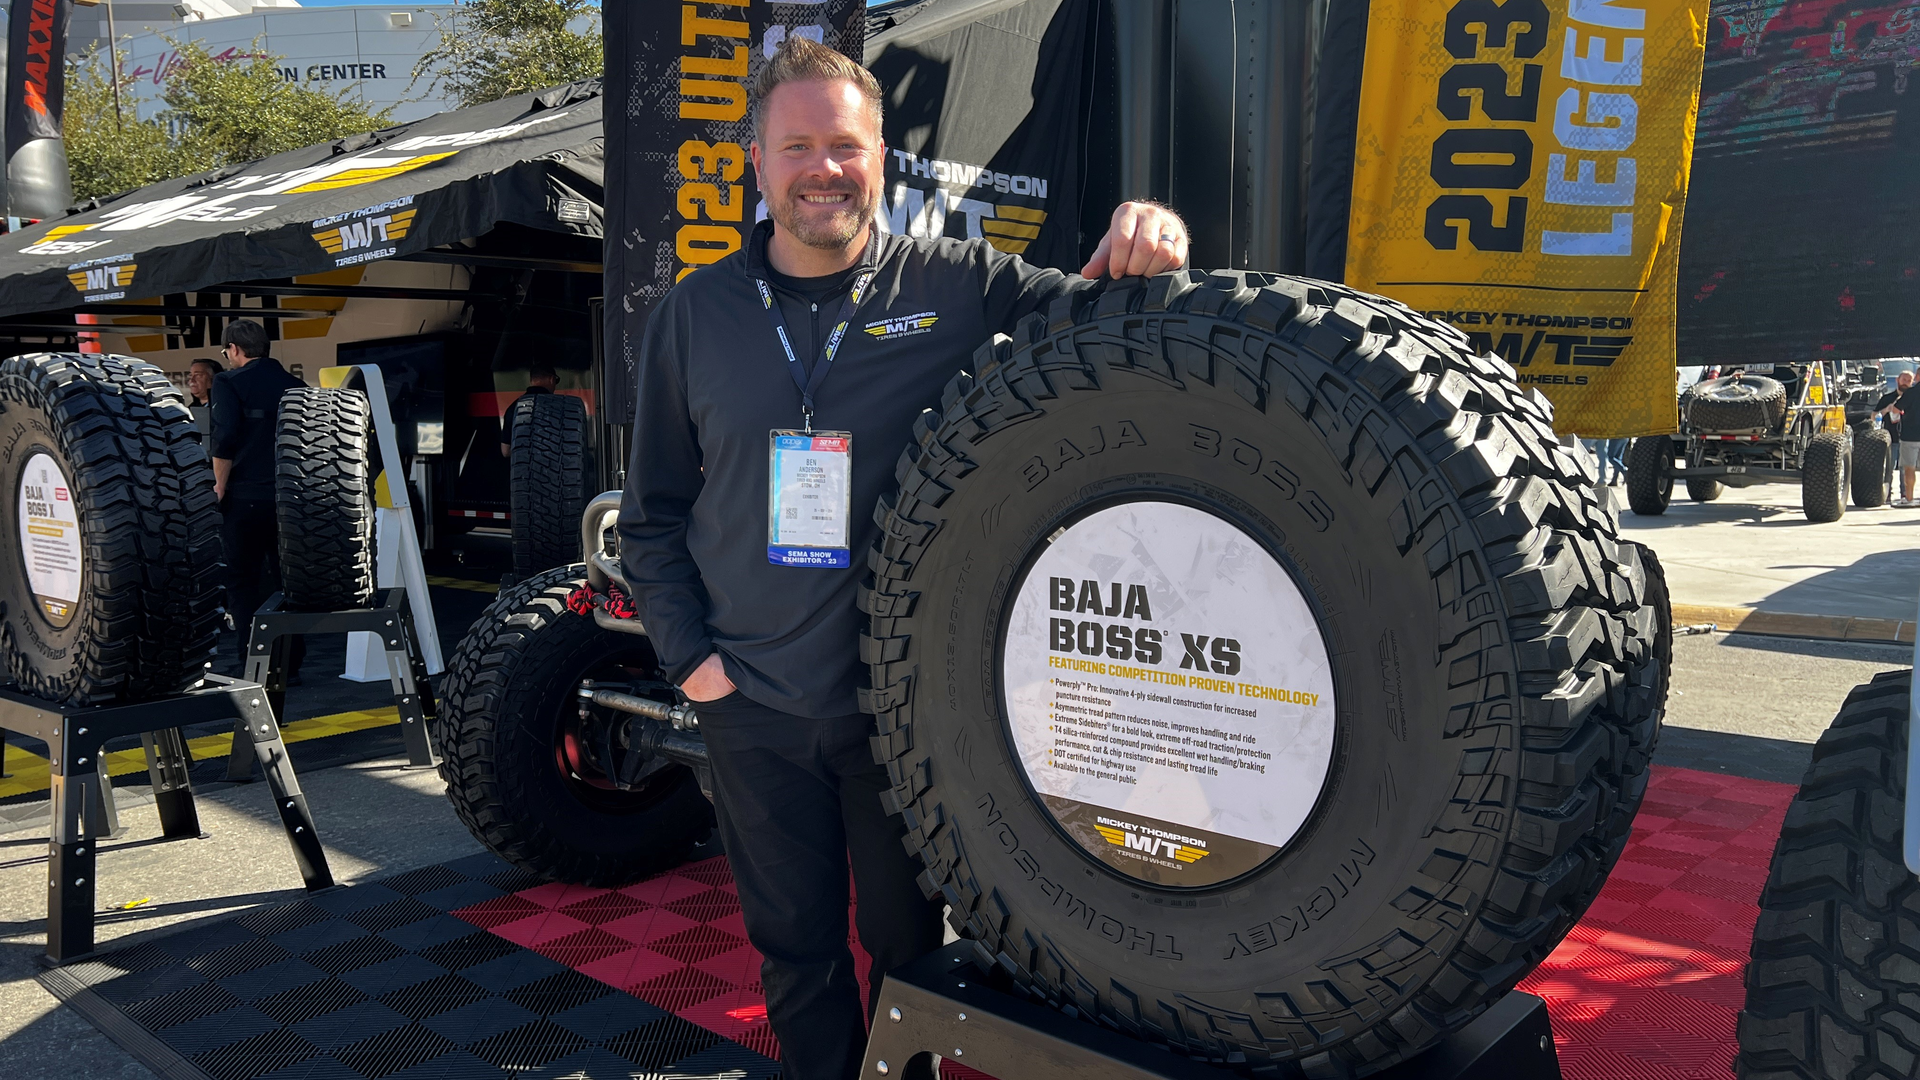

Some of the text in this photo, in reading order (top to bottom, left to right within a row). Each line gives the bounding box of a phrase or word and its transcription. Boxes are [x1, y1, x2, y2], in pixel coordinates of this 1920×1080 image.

[24, 0, 58, 116] MAXXI
[307, 63, 387, 81] CENTER
[1424, 0, 1550, 253] 2023
[893, 149, 1048, 199] THOMPSON
[312, 194, 415, 229] MICKEY THOMPSON
[339, 215, 393, 251] M/T
[335, 254, 358, 267] TIRES
[364, 247, 397, 261] WHEELS
[86, 265, 121, 291] M/T
[865, 311, 937, 329] MICKEY THOMPSON
[875, 333, 898, 341] TIRES
[903, 328, 932, 337] WHEELS
[885, 319, 923, 334] M/T
[1419, 310, 1634, 330] ICKEY THOMPSON
[1516, 374, 1589, 386] WHEELS
[806, 458, 817, 466] BEN
[1015, 420, 1148, 494] BAJA
[1184, 422, 1336, 534] BOSS
[25, 485, 44, 501] BAJA
[27, 501, 55, 518] BOSS X
[782, 556, 822, 564] EXHIBITOR
[1285, 543, 1335, 615] OUTSIDE
[1049, 576, 1152, 622] BAJA
[1179, 632, 1242, 676] XS
[1049, 656, 1319, 707] FEATURING COMPETITION PROVEN TECHNOLOGY
[1055, 691, 1112, 707] puncture resistance
[1087, 685, 1099, 693] Pro:
[1100, 685, 1130, 698] Innovative
[1130, 690, 1146, 701] 4-ply
[1147, 692, 1171, 704] sidewall
[1172, 698, 1213, 711] construction
[1213, 703, 1223, 712] for
[1224, 704, 1257, 718] increased
[1054, 702, 1256, 745] Asymmetric tread pattern reduces noise, improves handling and ride
[1054, 713, 1078, 725] Extreme
[1112, 724, 1121, 732] for
[1126, 726, 1139, 736] bold
[1140, 729, 1155, 739] look,
[1156, 732, 1181, 744] extreme
[1182, 736, 1207, 749] off-road
[1208, 741, 1271, 761] traction/protection
[1054, 725, 1265, 775] T4 silica-reinforced compound provides excellent wet handling/braking
[1054, 738, 1218, 777] performance, cut & chip resistance and lasting tread life
[1054, 748, 1136, 773] DOT certified for highway use
[1053, 760, 1137, 785] Available to the general public
[1097, 816, 1206, 848] MICKEY THOMPSON
[1124, 831, 1181, 859] M/T
[1116, 849, 1142, 860] TIRES
[1149, 857, 1183, 871] WHEELS
[975, 792, 1377, 962] THOMPSON MICKEY
